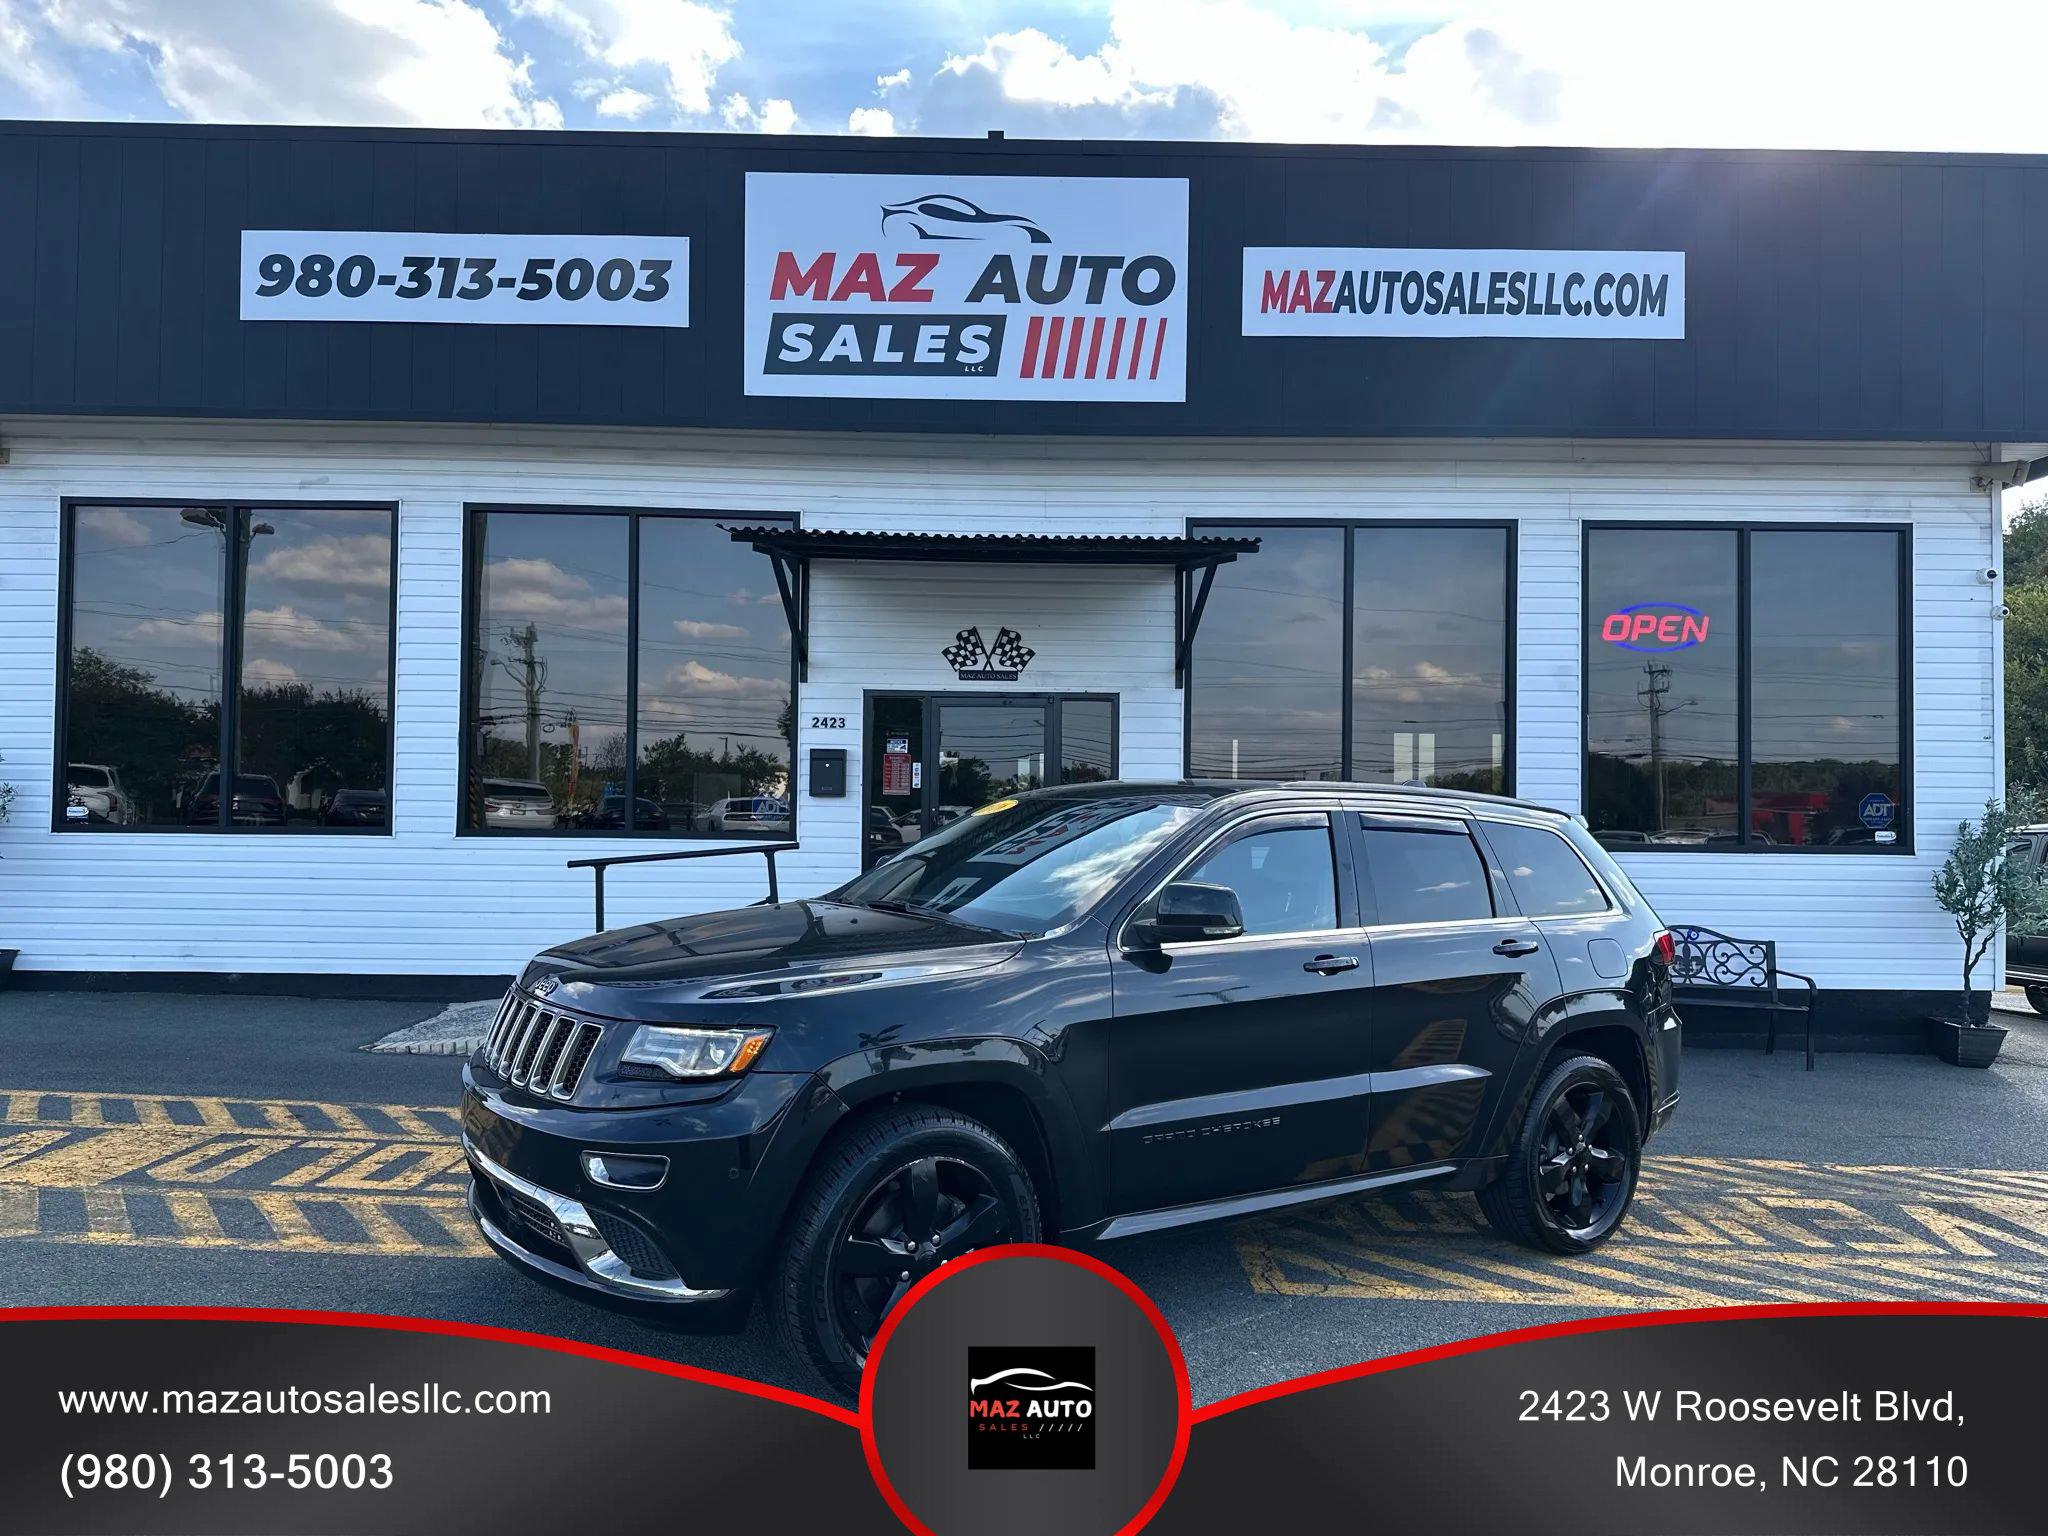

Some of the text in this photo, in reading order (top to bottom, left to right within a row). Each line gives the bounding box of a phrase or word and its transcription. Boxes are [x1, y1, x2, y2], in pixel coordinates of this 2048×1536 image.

[255, 253, 673, 303] 980-313-5003
[769, 251, 1176, 306] MAZ AUTO
[1260, 269, 1669, 317] MAZAUTOSALESLLC.COM
[778, 323, 993, 364] SALES
[1602, 614, 1710, 643] OPEN
[811, 716, 846, 729] 2423
[1863, 803, 1891, 817] ADT
